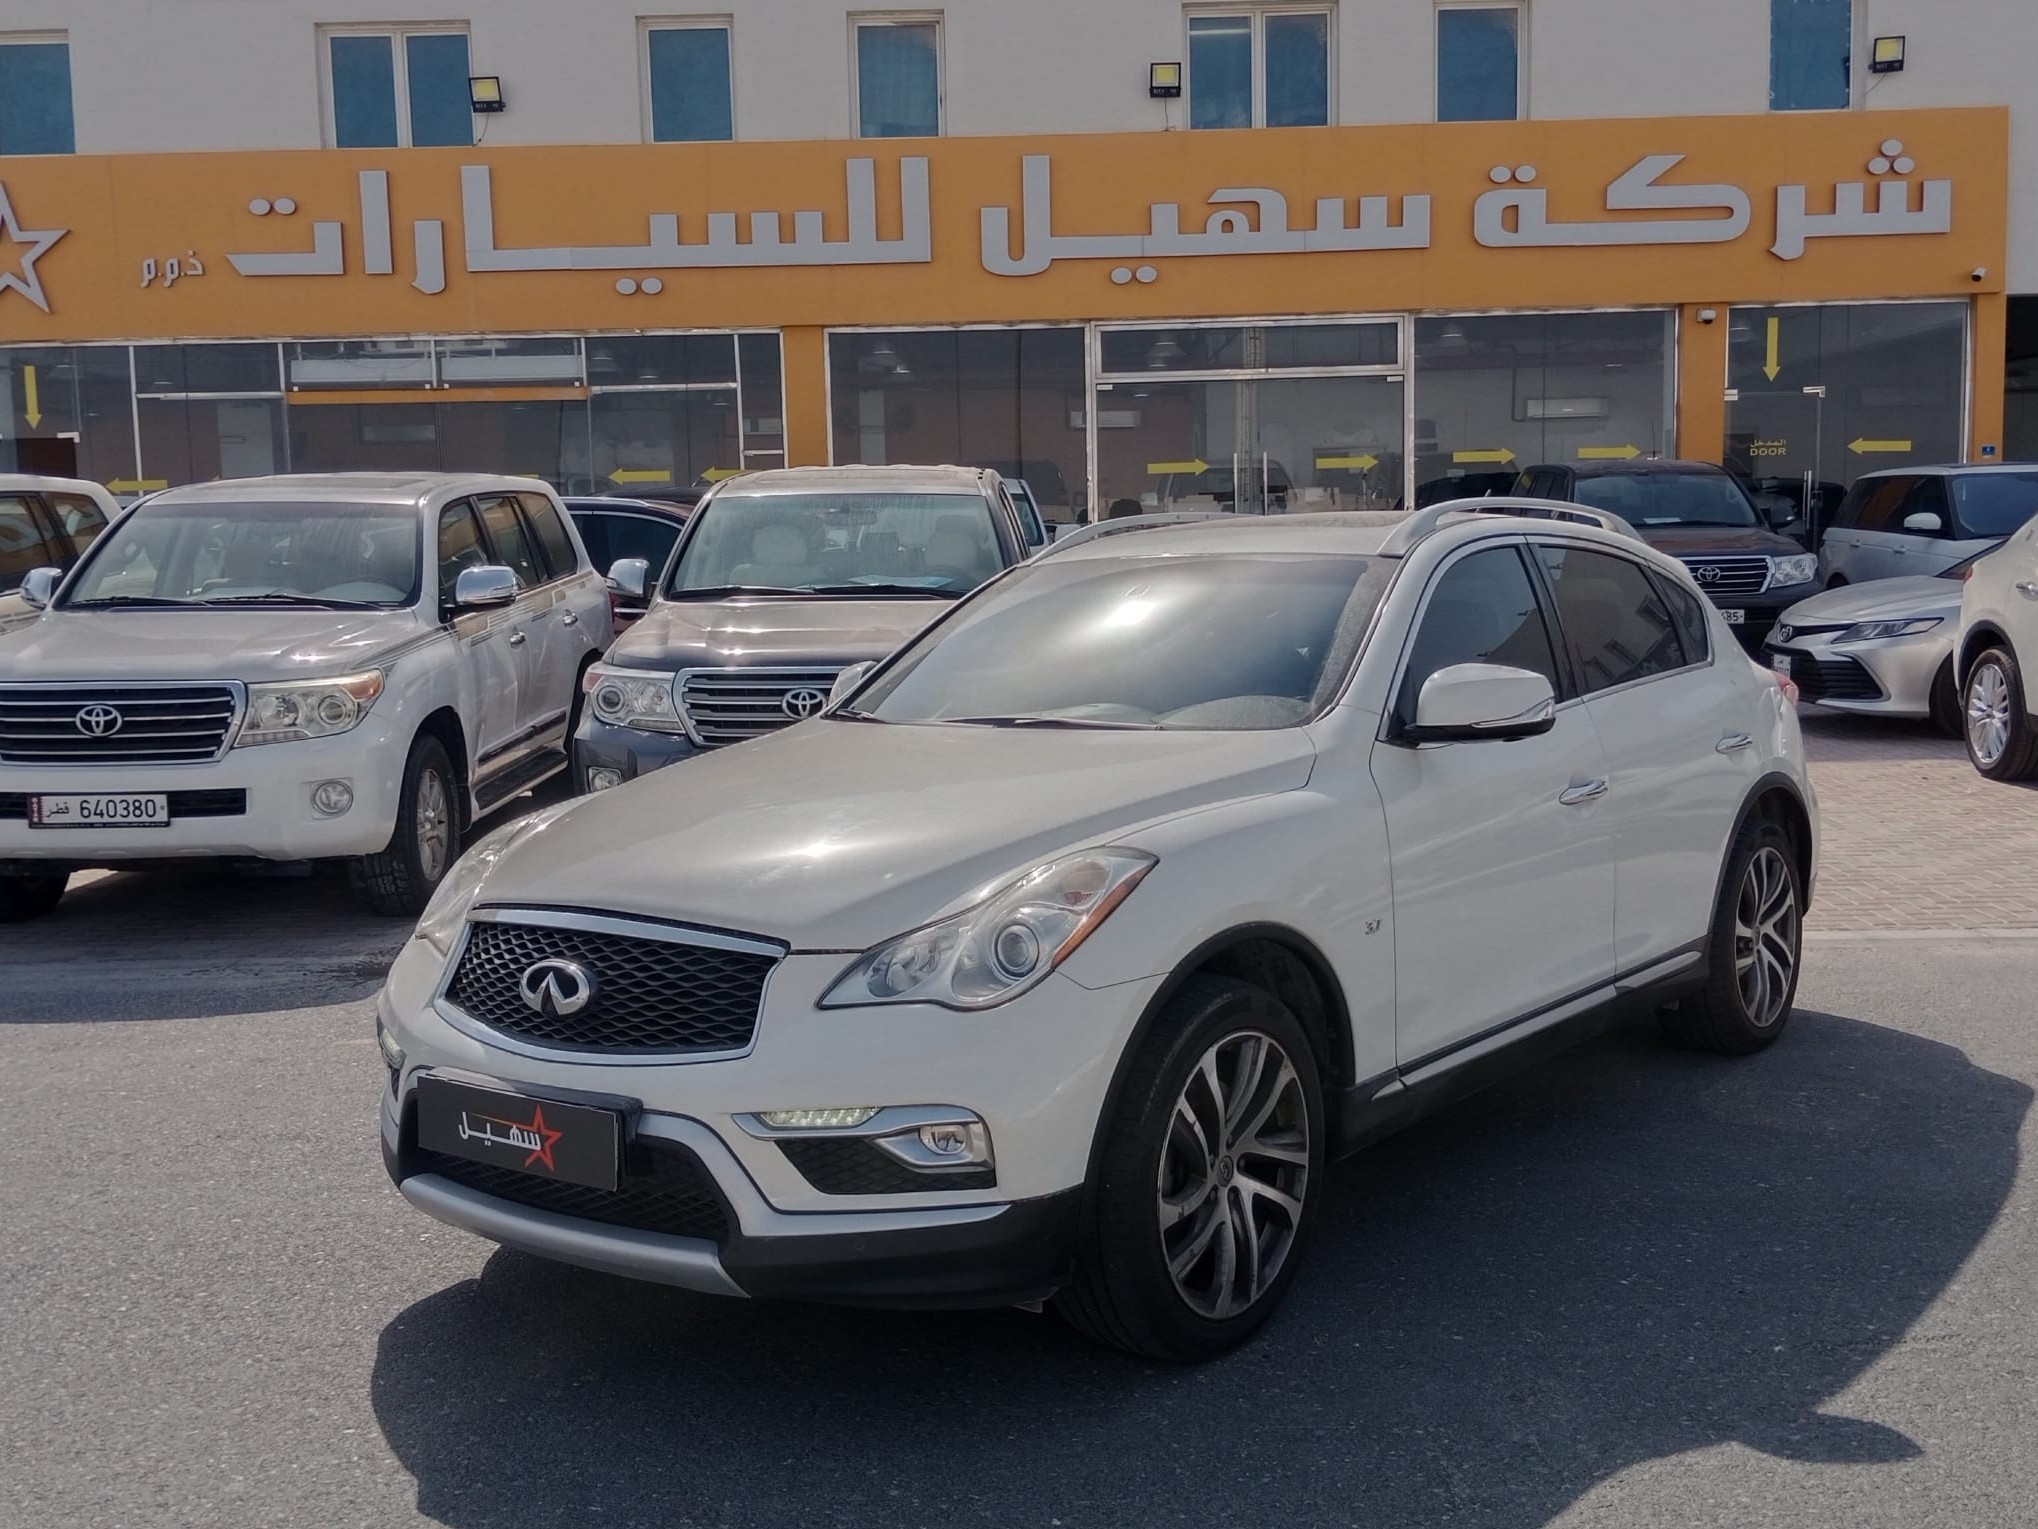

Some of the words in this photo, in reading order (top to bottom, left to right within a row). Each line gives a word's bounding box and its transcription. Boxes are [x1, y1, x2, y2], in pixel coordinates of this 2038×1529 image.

[225, 156, 932, 295] للسيارات
[980, 154, 1431, 285] سهيل
[1473, 137, 1952, 261] شركة
[1750, 447, 1787, 456] DOOR
[45, 801, 69, 818] قطر
[79, 799, 157, 819] 640380
[458, 1111, 542, 1151] سهيل
